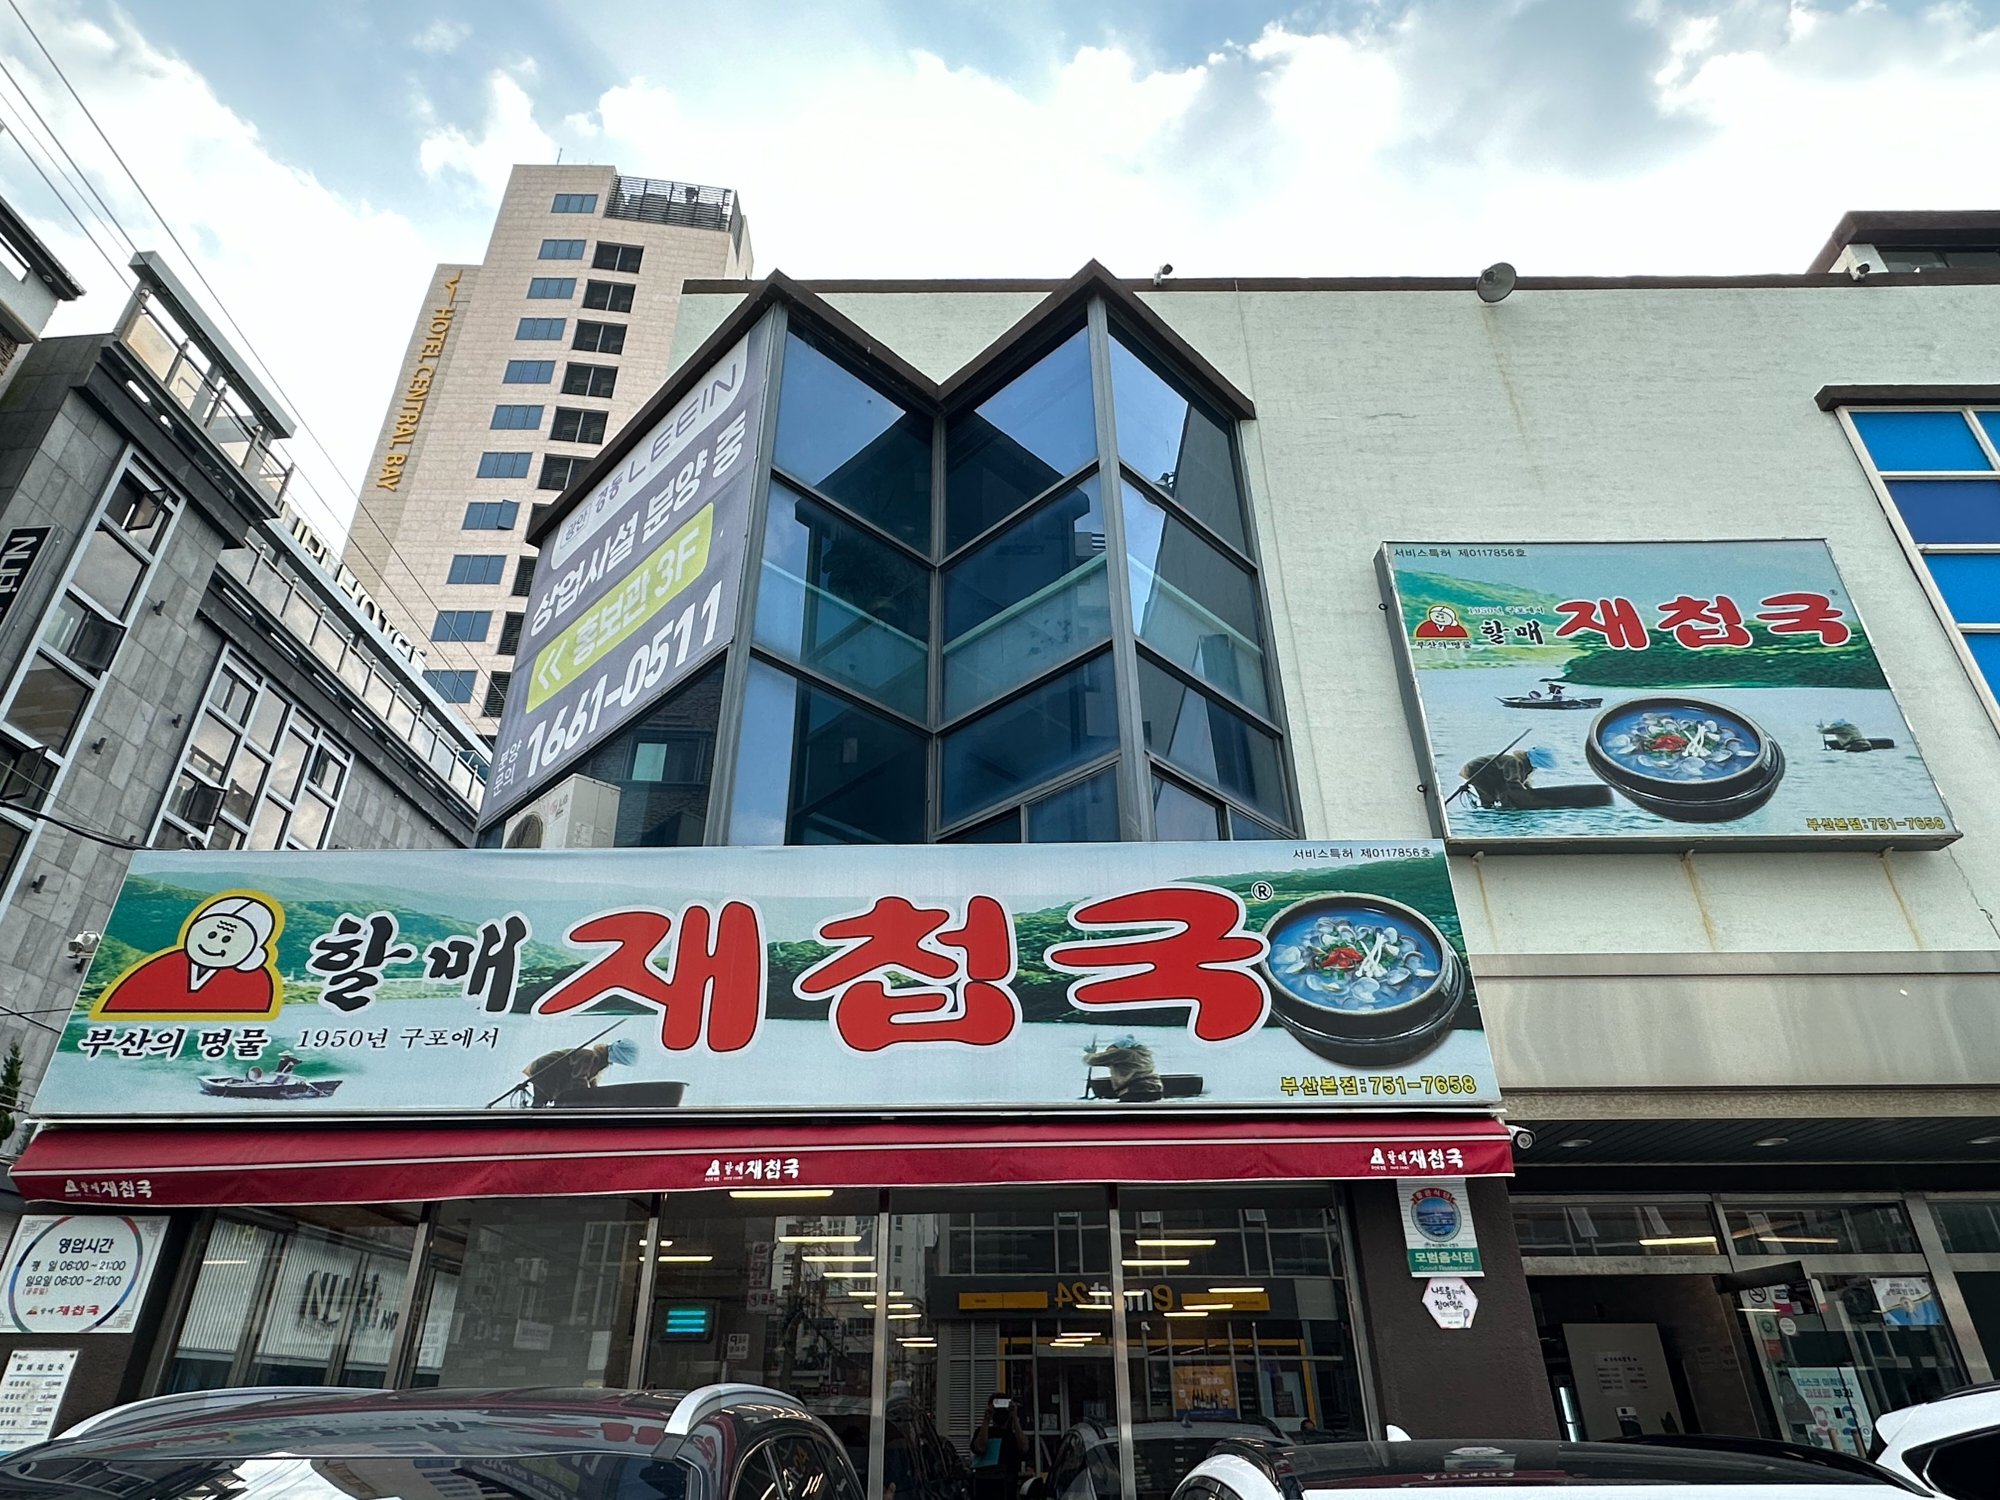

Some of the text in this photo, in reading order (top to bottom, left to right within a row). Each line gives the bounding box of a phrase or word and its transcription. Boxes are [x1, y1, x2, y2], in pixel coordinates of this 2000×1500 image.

[377, 307, 454, 492] HOTEL CENTRAL BAY
[628, 363, 737, 483] LEEIN
[530, 409, 746, 637] 상업시설 분양 중
[1394, 548, 1527, 559] 서비스특허 제0117856호
[573, 526, 700, 666] 홍보관 3F
[1481, 592, 1848, 648] 할매 재첩국
[527, 580, 722, 778] 1661-0511
[497, 739, 521, 769] 분양
[492, 765, 514, 797] 문의
[1806, 817, 1945, 831] 부산본점:751-7658
[1293, 848, 1433, 859] 서비스특허 제0117856호
[309, 914, 527, 1012] 할매
[537, 887, 1264, 1053] 재첩국
[82, 1028, 269, 1057] 부산의 명물
[296, 1026, 500, 1049] 1950년 구포에서
[1280, 1075, 1476, 1096] 부산본점:751-7658
[745, 1158, 799, 1180] 재첩국
[1409, 1147, 1463, 1169] 재첩국
[100, 1179, 152, 1198] 재첩국
[59, 1238, 114, 1254] 영업시간
[60, 1260, 89, 1271] 06:00
[99, 1260, 126, 1271] 21:00
[1415, 1251, 1474, 1264] 모범음식점
[25, 1276, 52, 1287] 일요일
[54, 1276, 83, 1286] 06:00
[93, 1276, 121, 1286] 21:00
[56, 1304, 100, 1316] 재첩국
